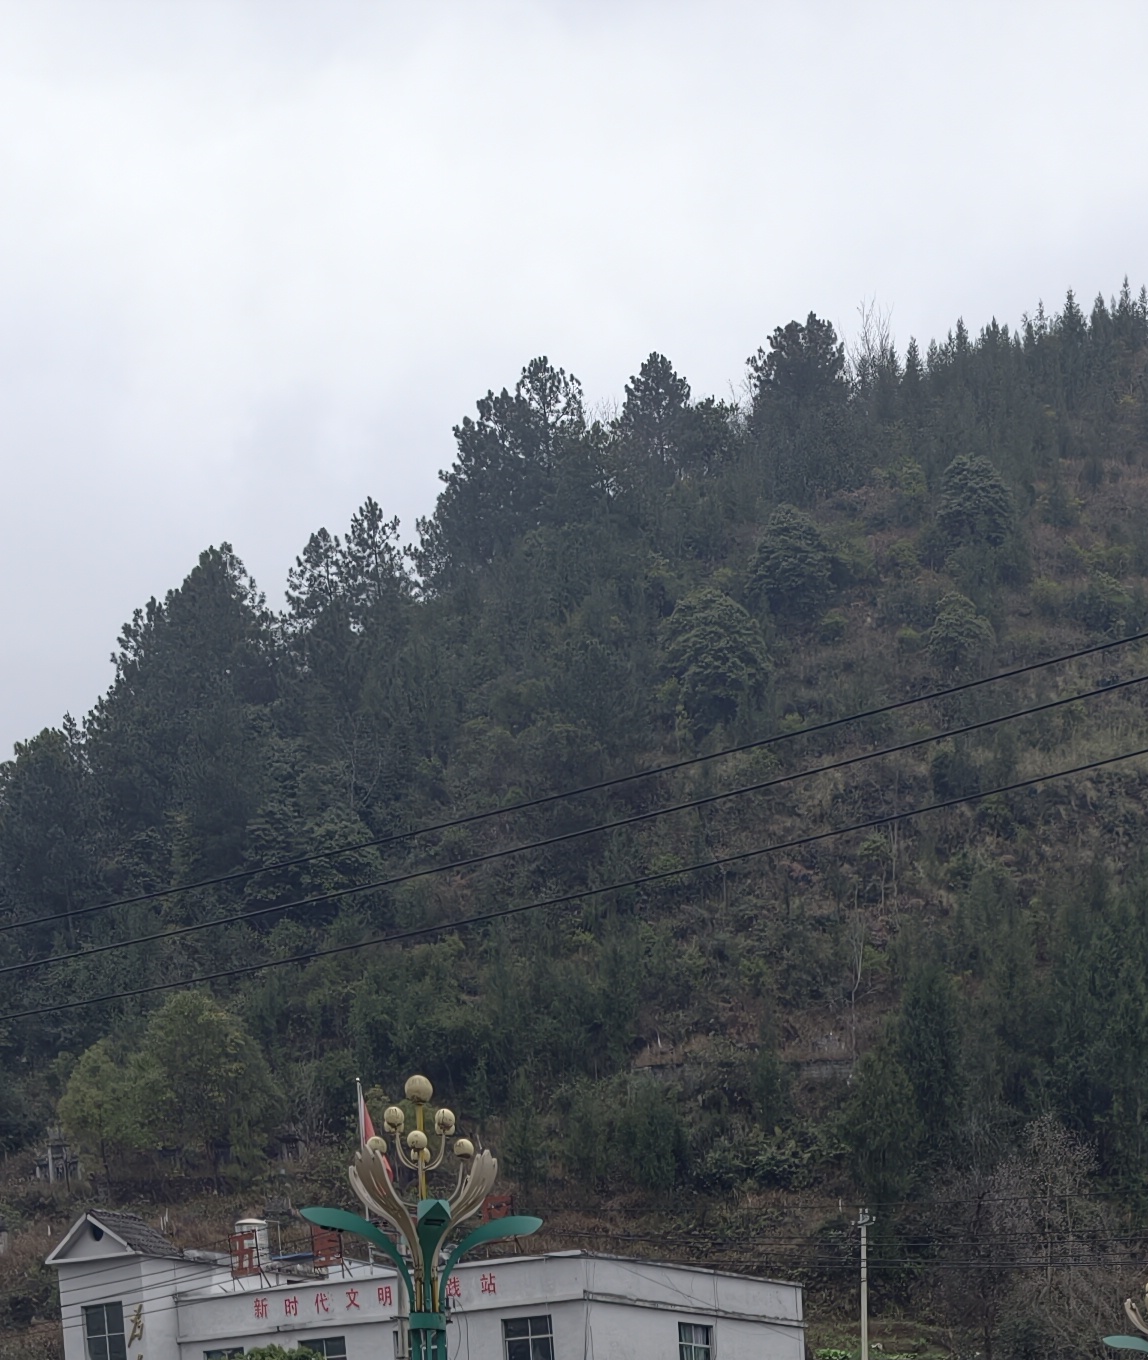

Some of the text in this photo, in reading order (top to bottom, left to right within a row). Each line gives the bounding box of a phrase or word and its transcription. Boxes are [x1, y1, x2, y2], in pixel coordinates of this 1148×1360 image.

[253, 1272, 496, 1320] 新时代文明践站
